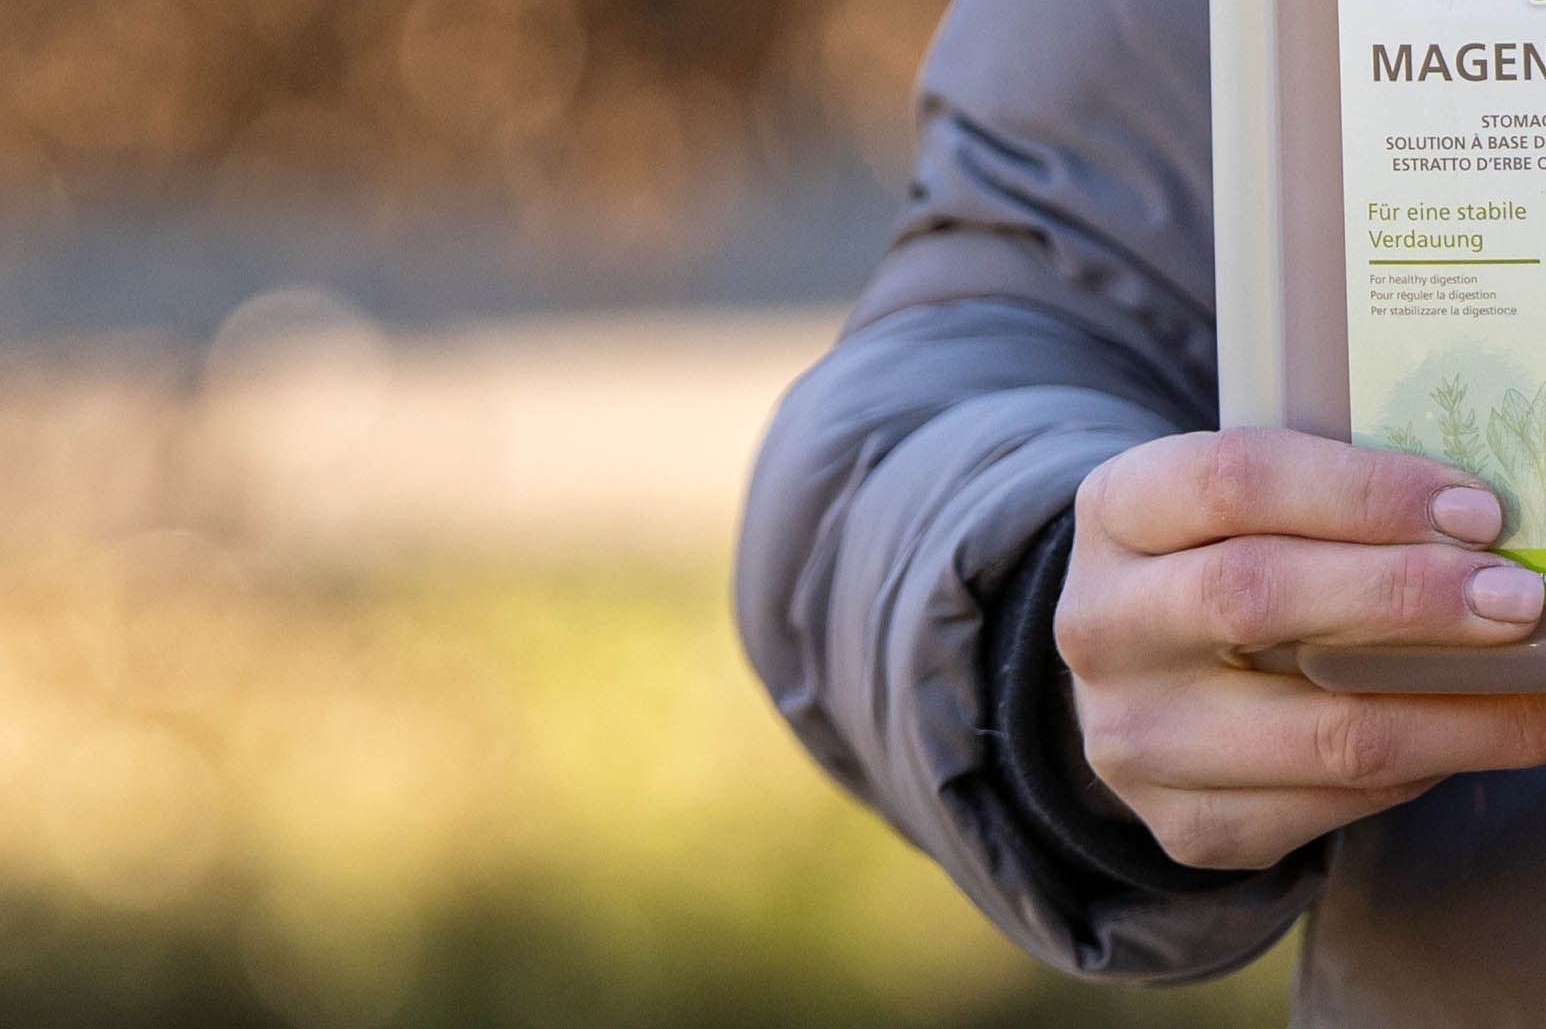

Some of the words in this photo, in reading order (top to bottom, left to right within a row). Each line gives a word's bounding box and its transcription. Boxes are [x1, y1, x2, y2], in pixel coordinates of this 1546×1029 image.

[1386, 134, 1466, 151] SOLUTION
[1471, 130, 1483, 150] À
[1487, 133, 1529, 149] BASE
[1392, 156, 1471, 172] ESTRATTO
[1476, 155, 1532, 171] D'ERBE
[1368, 202, 1400, 221] Für
[1407, 202, 1451, 221] eine
[1457, 201, 1527, 221] stabile
[1368, 230, 1484, 253] Verdauung
[1369, 274, 1386, 285] For
[1388, 274, 1427, 287] healthy
[1429, 274, 1478, 287] digestion
[1370, 291, 1394, 301] Pour
[1436, 290, 1446, 300] la
[1448, 290, 1497, 302] digestion
[1370, 306, 1388, 316] Per
[1389, 306, 1448, 316] stabilizzare
[1450, 306, 1460, 316] la
[1462, 305, 1518, 318] digestione
